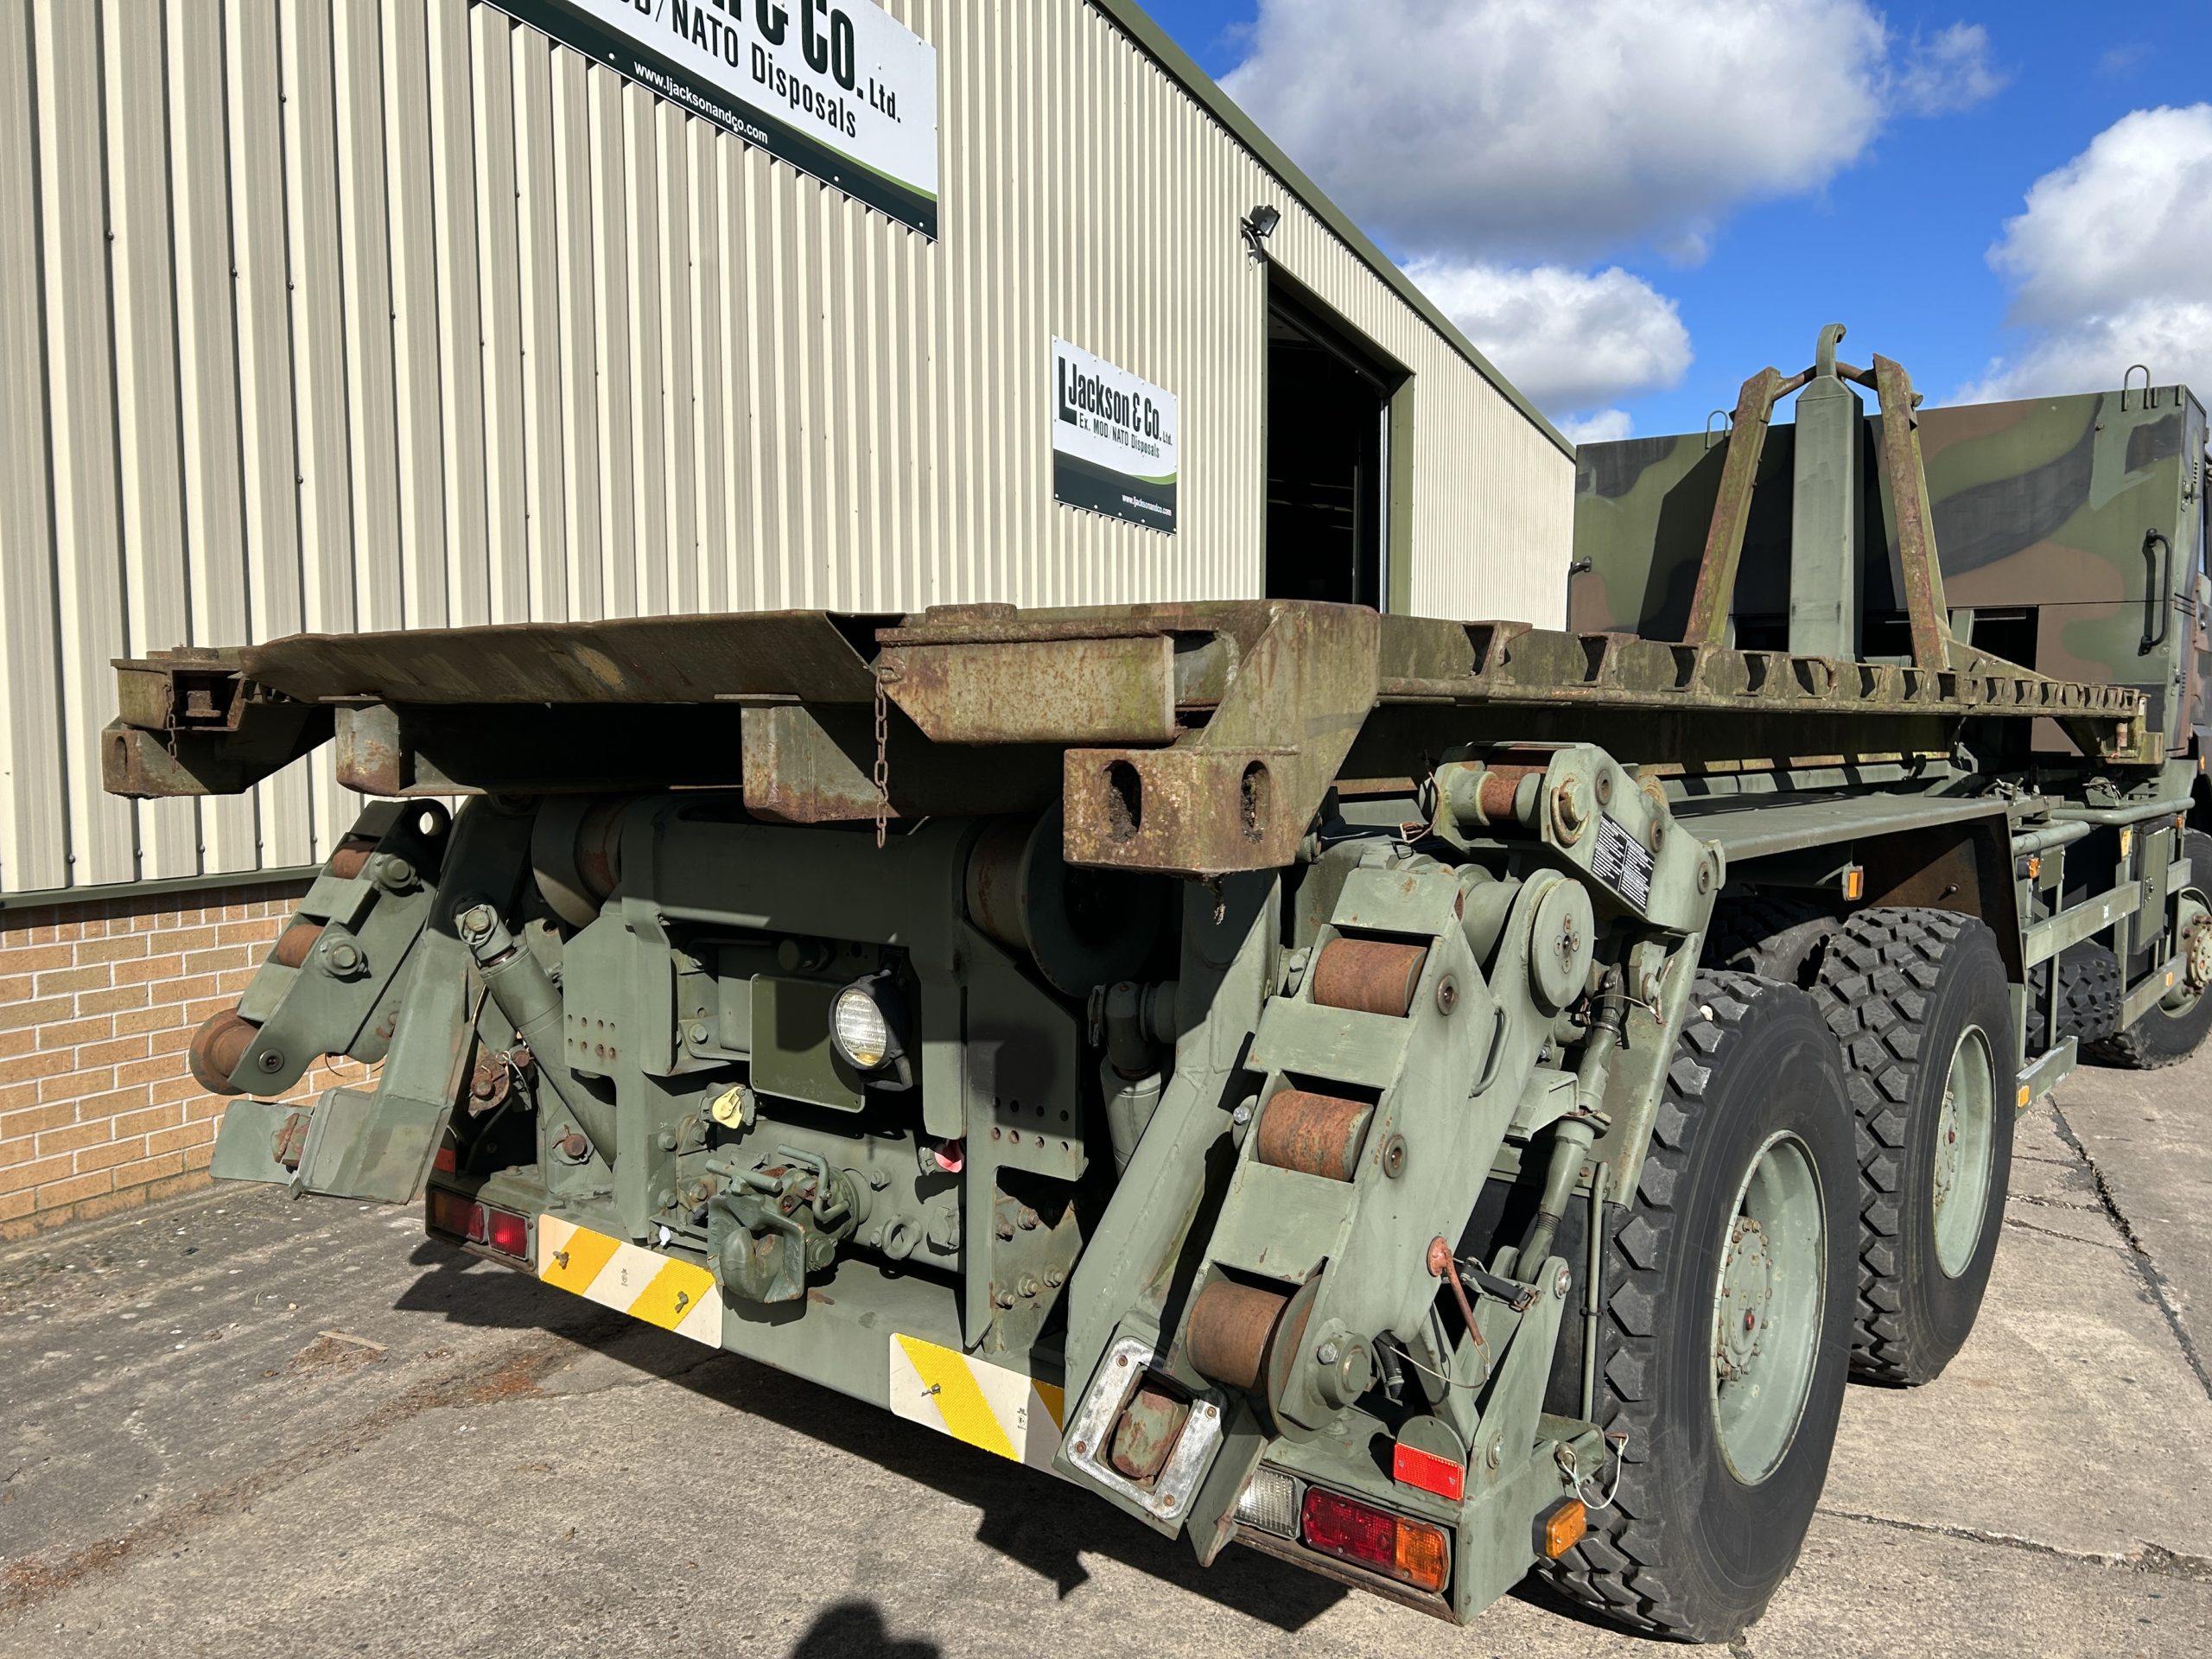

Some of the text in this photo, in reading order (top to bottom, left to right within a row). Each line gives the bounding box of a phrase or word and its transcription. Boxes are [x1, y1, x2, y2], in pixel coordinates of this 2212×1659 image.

[633, 61, 768, 144] www.ljacksonandco.com
[752, 41, 856, 138] Disposals
[869, 77, 901, 123] Ltd.
[1079, 412, 1160, 458] Ex. MOD/NATO Disposals
[1133, 392, 1141, 432] &
[1144, 397, 1161, 442] Co.
[1163, 430, 1173, 446] Ltd.
